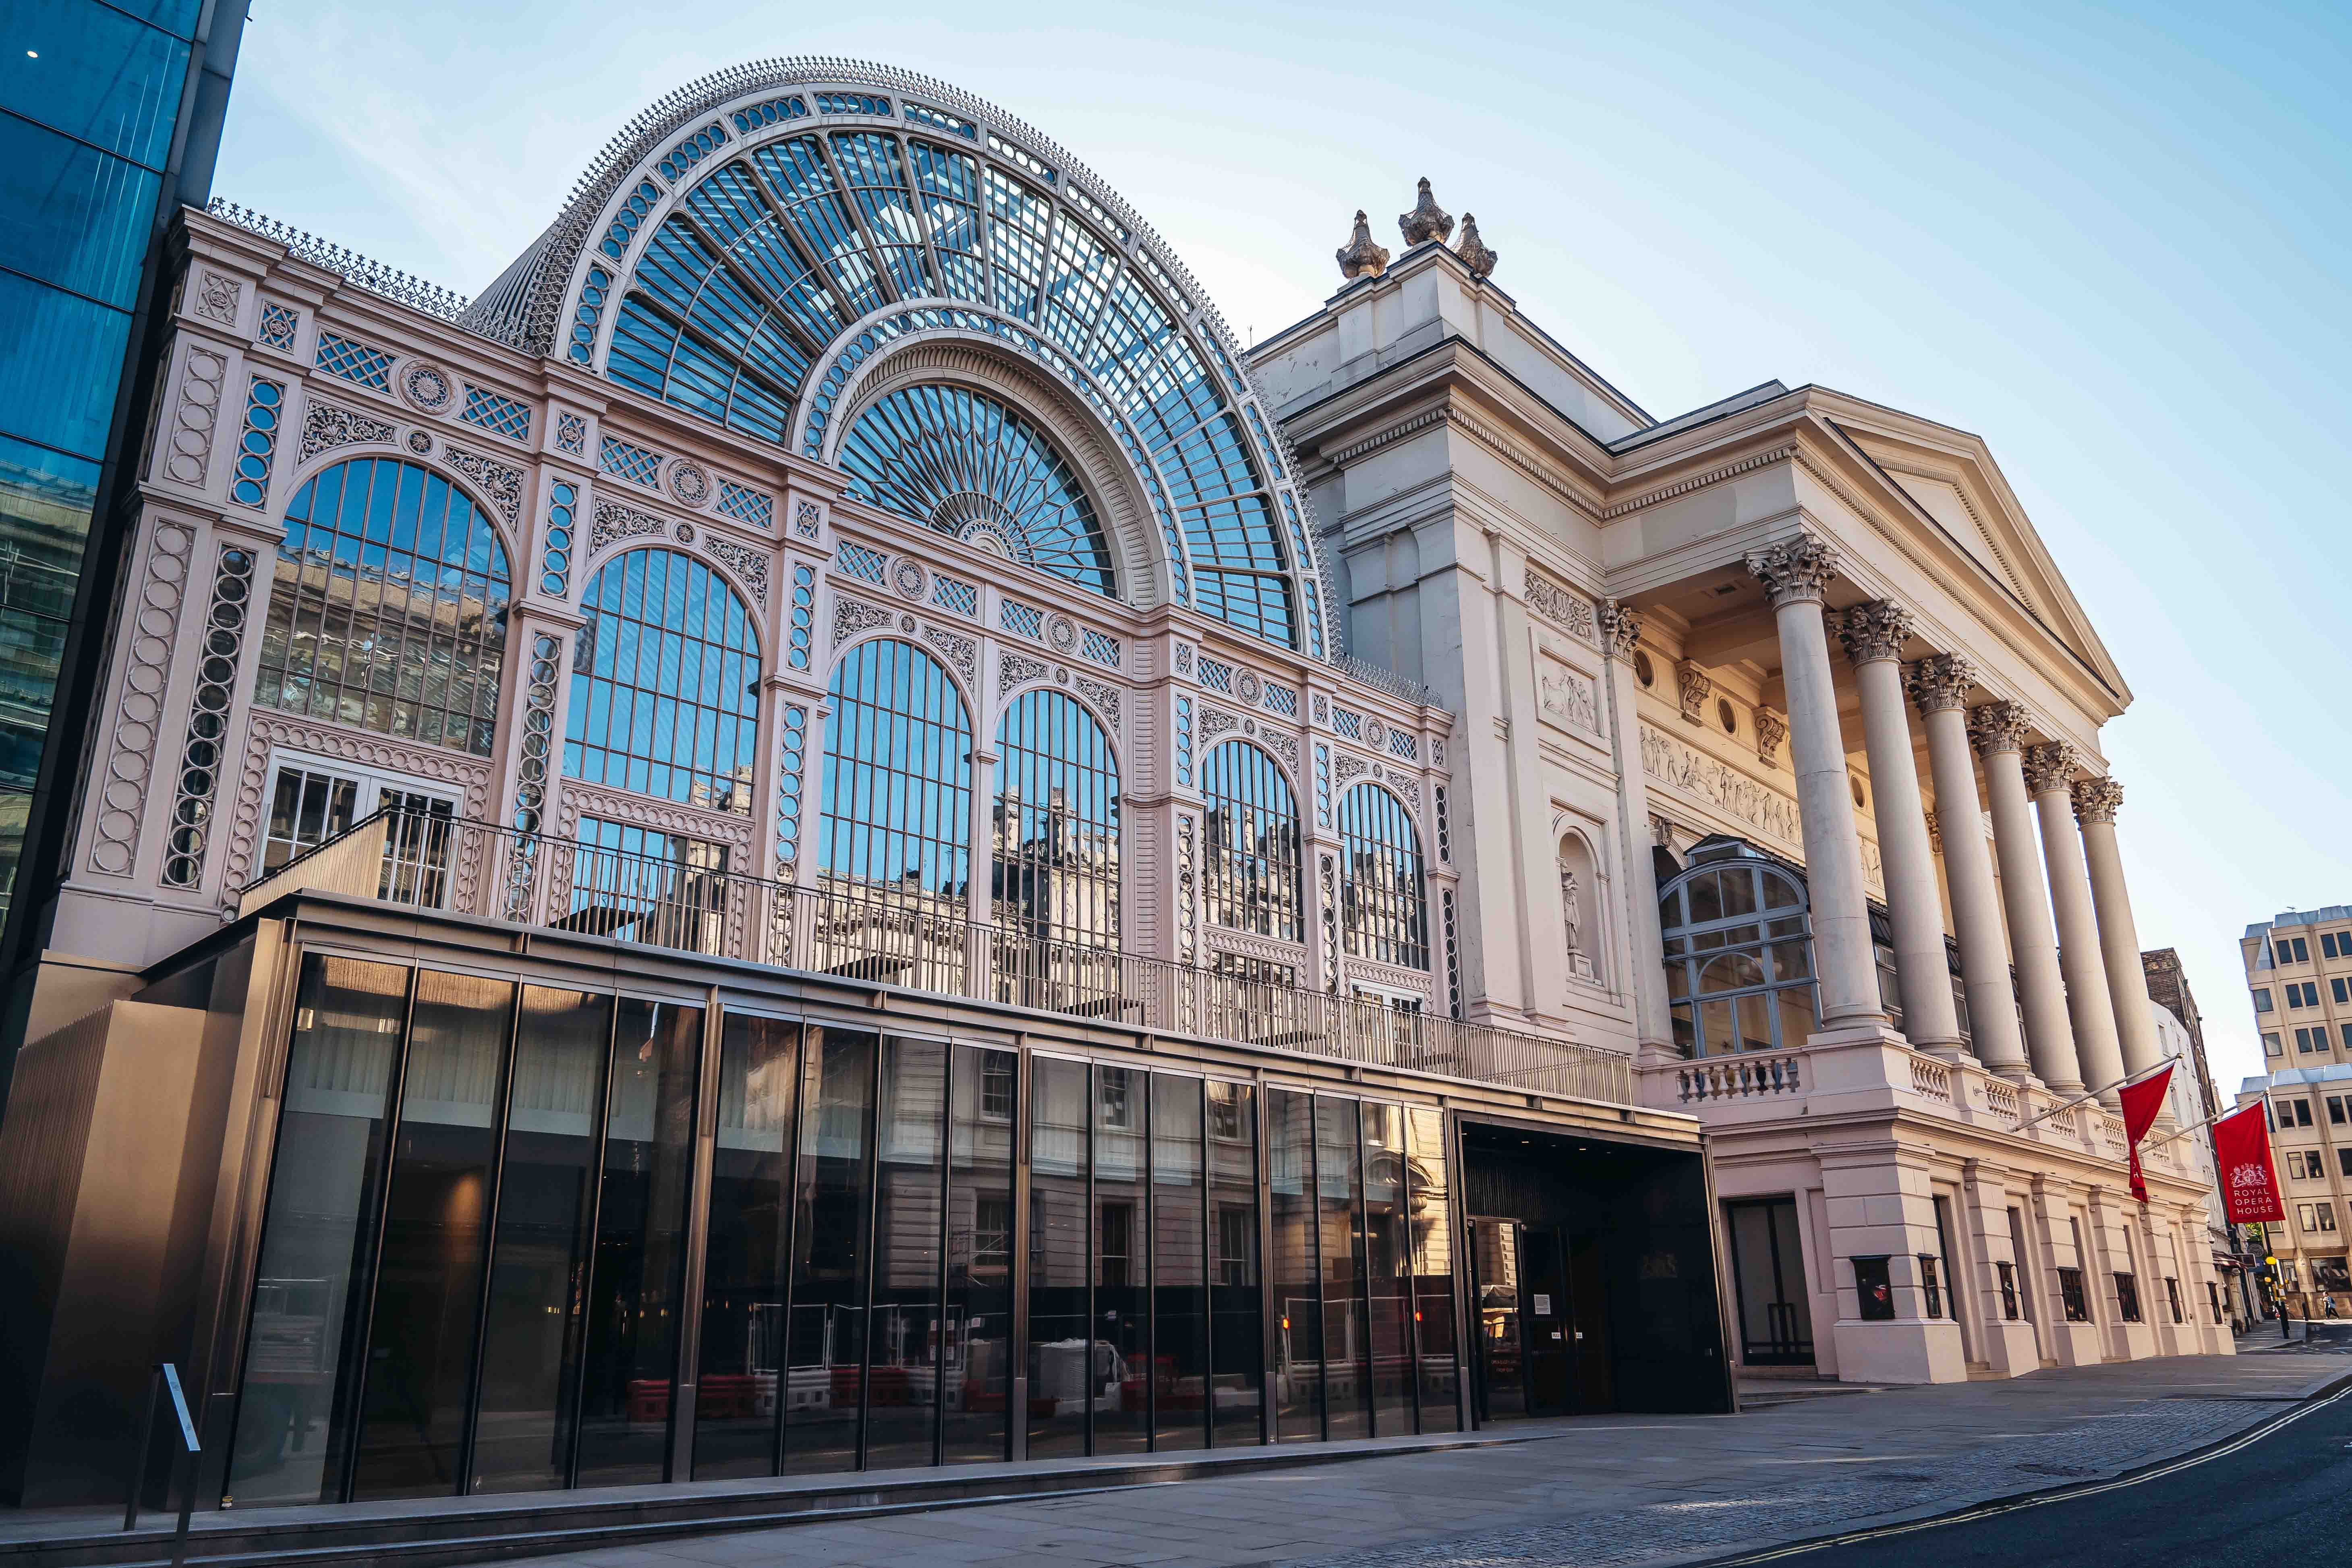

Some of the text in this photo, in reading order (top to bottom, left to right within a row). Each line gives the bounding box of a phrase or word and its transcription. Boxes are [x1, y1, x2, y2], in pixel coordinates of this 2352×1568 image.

[2234, 1188, 2269, 1197] ROYAL
[2235, 1197, 2272, 1206] OPERA
[2237, 1206, 2273, 1214] HOUSE
